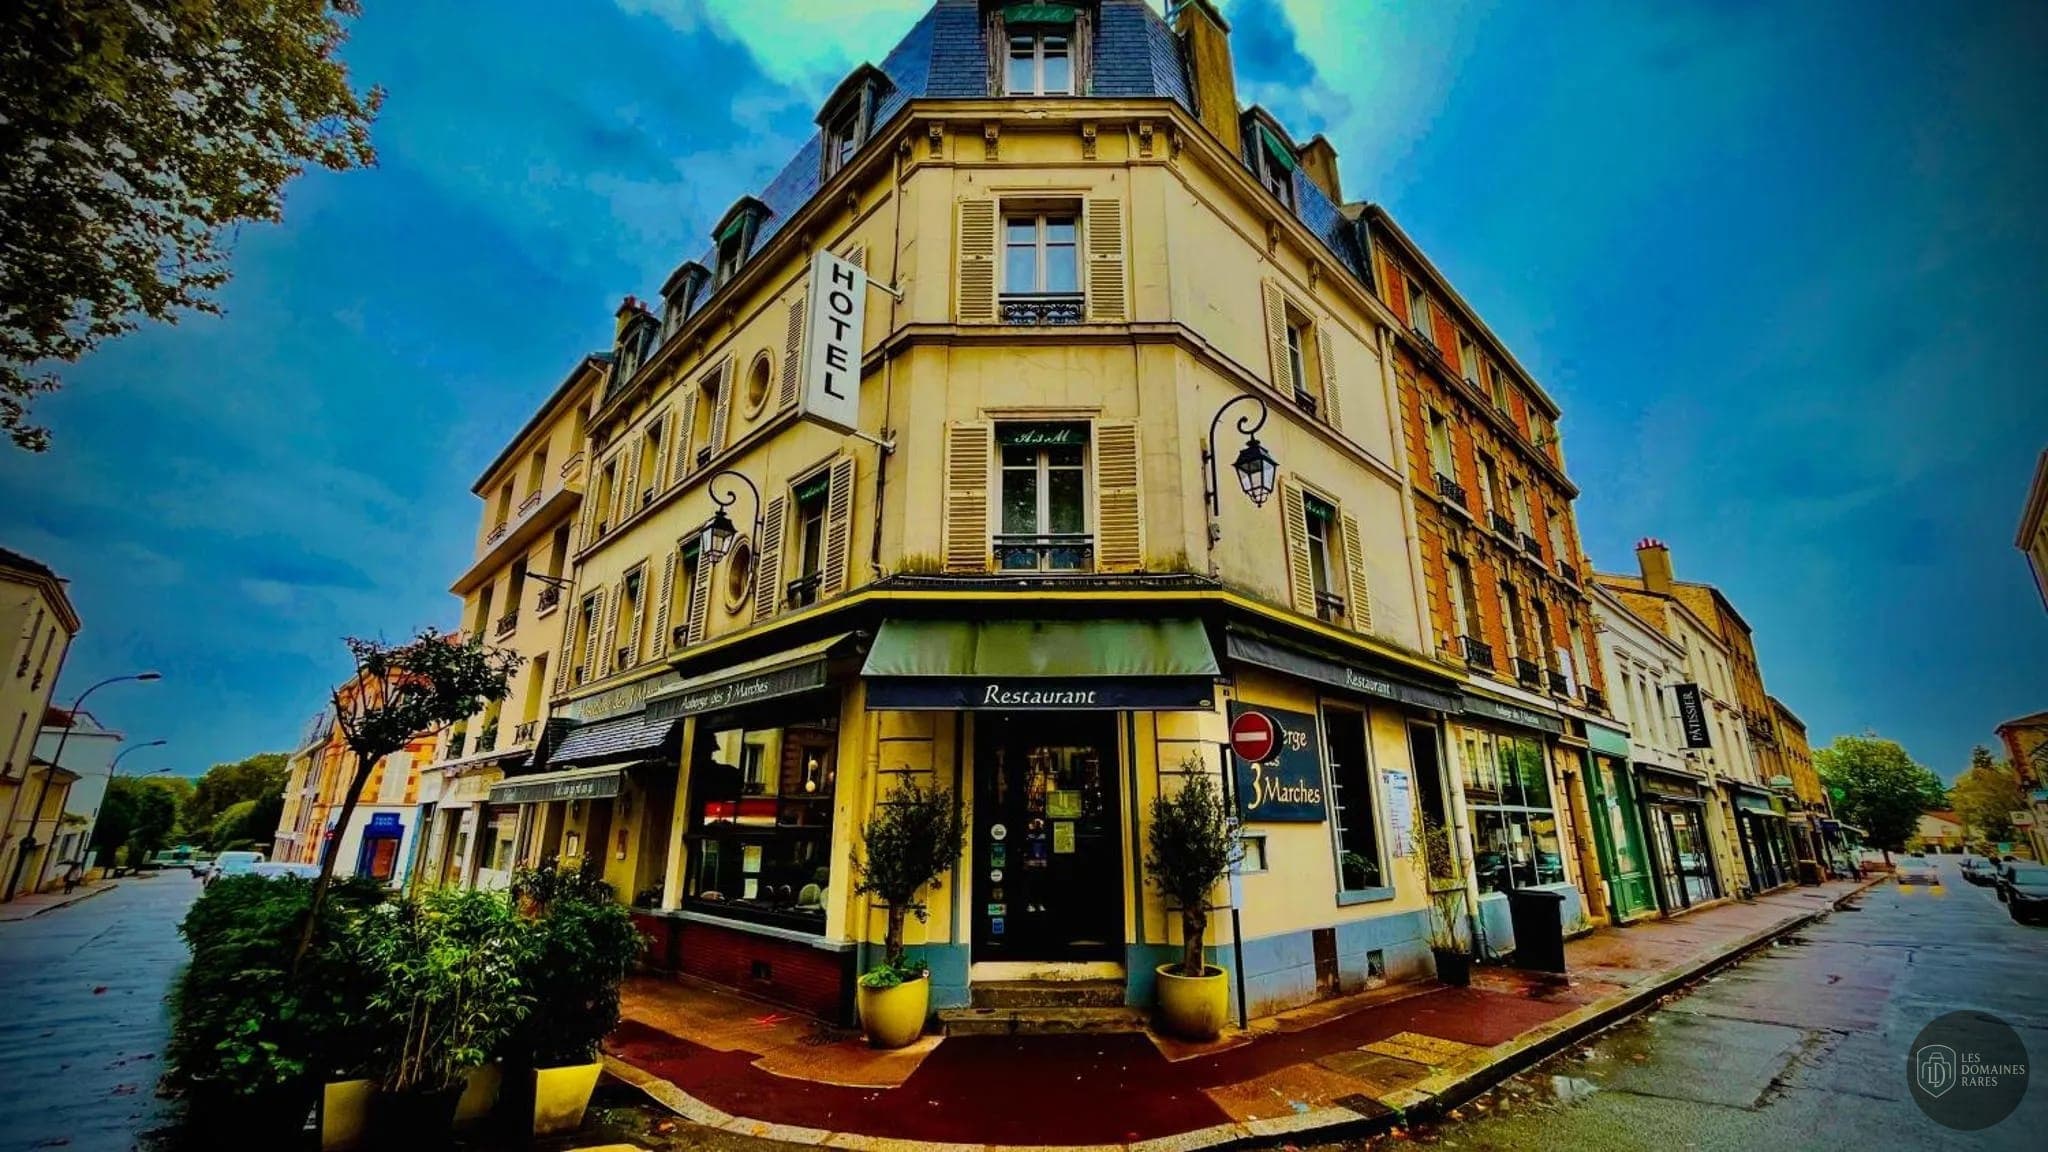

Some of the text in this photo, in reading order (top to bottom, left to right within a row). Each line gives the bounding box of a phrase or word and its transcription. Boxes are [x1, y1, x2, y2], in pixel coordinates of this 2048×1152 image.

[824, 263, 854, 400] HOTEL
[710, 688, 724, 704] des
[724, 684, 733, 705] 3
[732, 678, 769, 702] Marches
[983, 684, 1097, 704] Restaurant
[1345, 667, 1392, 697] Restaurant
[1283, 729, 1308, 752] erge
[1247, 762, 1321, 810] 3 Marches
